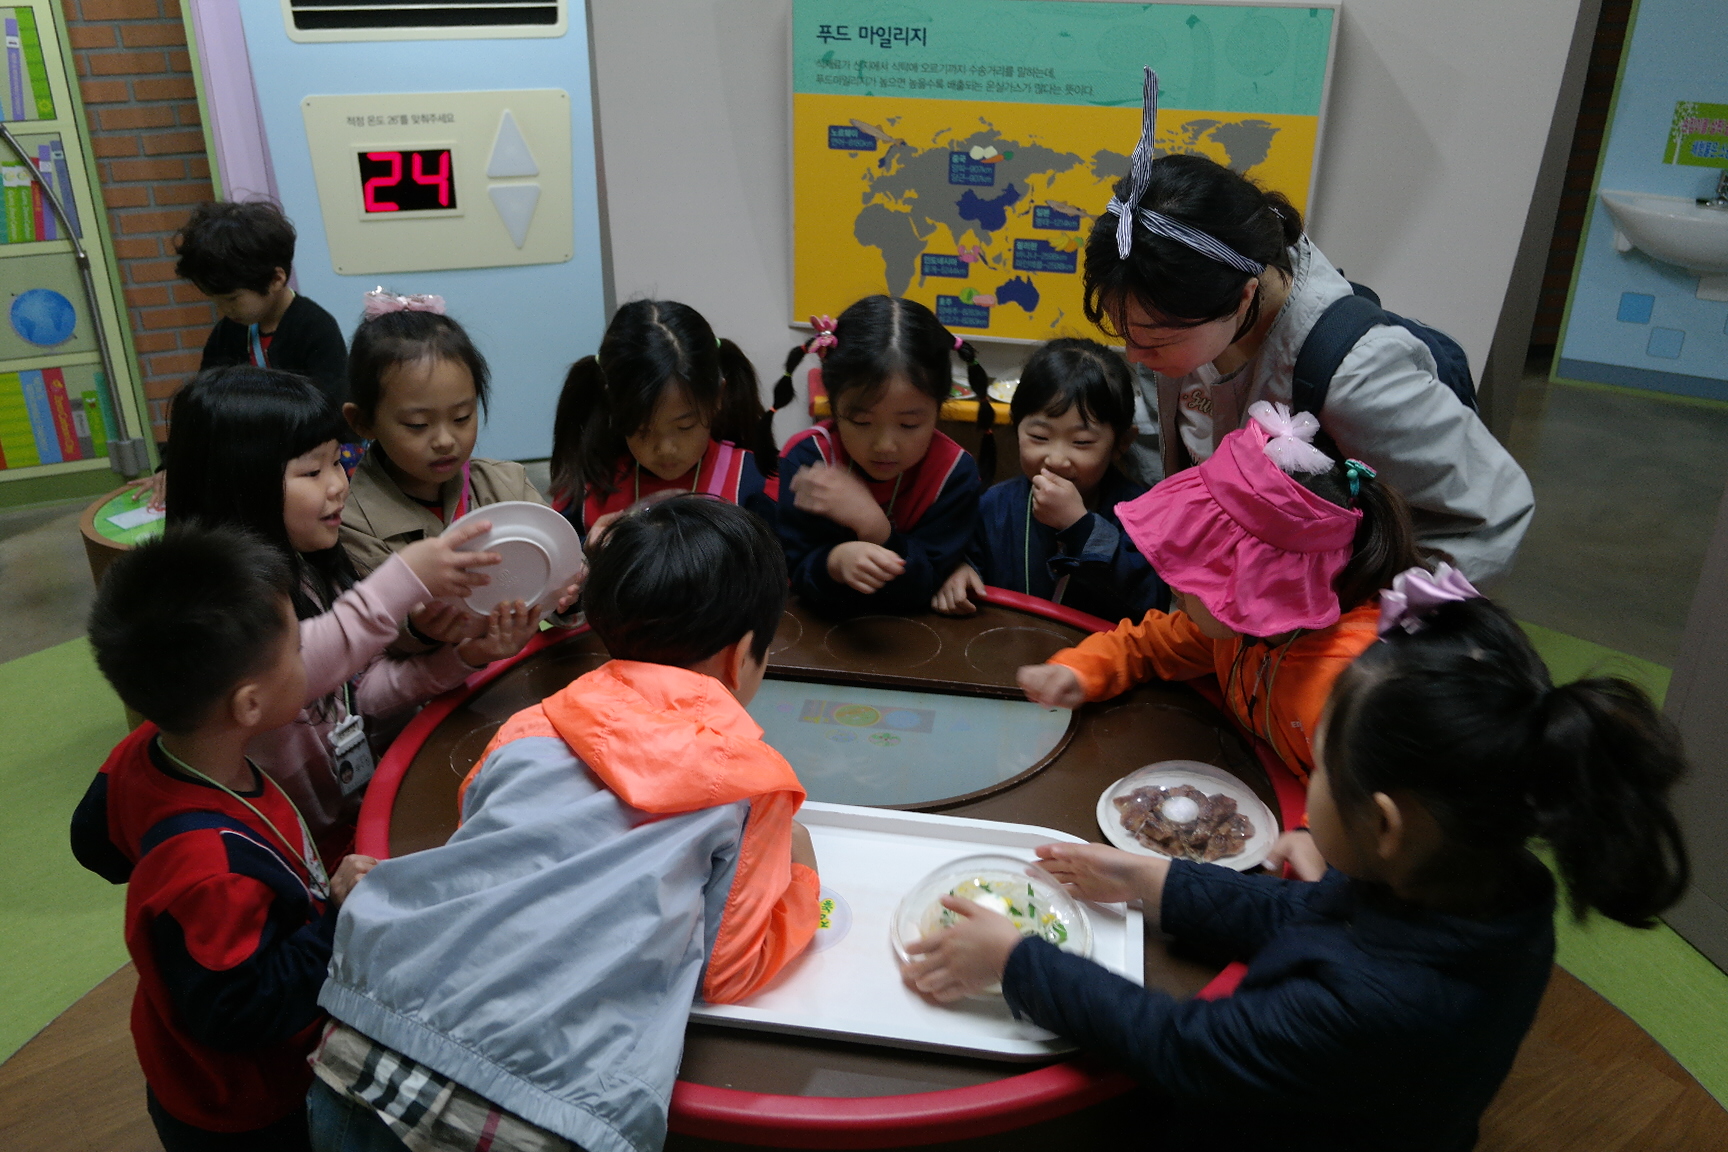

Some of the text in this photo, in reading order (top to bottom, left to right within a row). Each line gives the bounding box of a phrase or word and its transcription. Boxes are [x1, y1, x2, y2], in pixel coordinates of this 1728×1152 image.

[816, 24, 927, 49] 푸드 마일리지
[921, 62, 966, 74] 오르기까지
[969, 64, 1014, 77] 수송거리를
[879, 76, 906, 88] 높으면
[986, 81, 1032, 93] 온실가스가
[367, 114, 385, 126] 온도
[364, 151, 451, 212] 24
